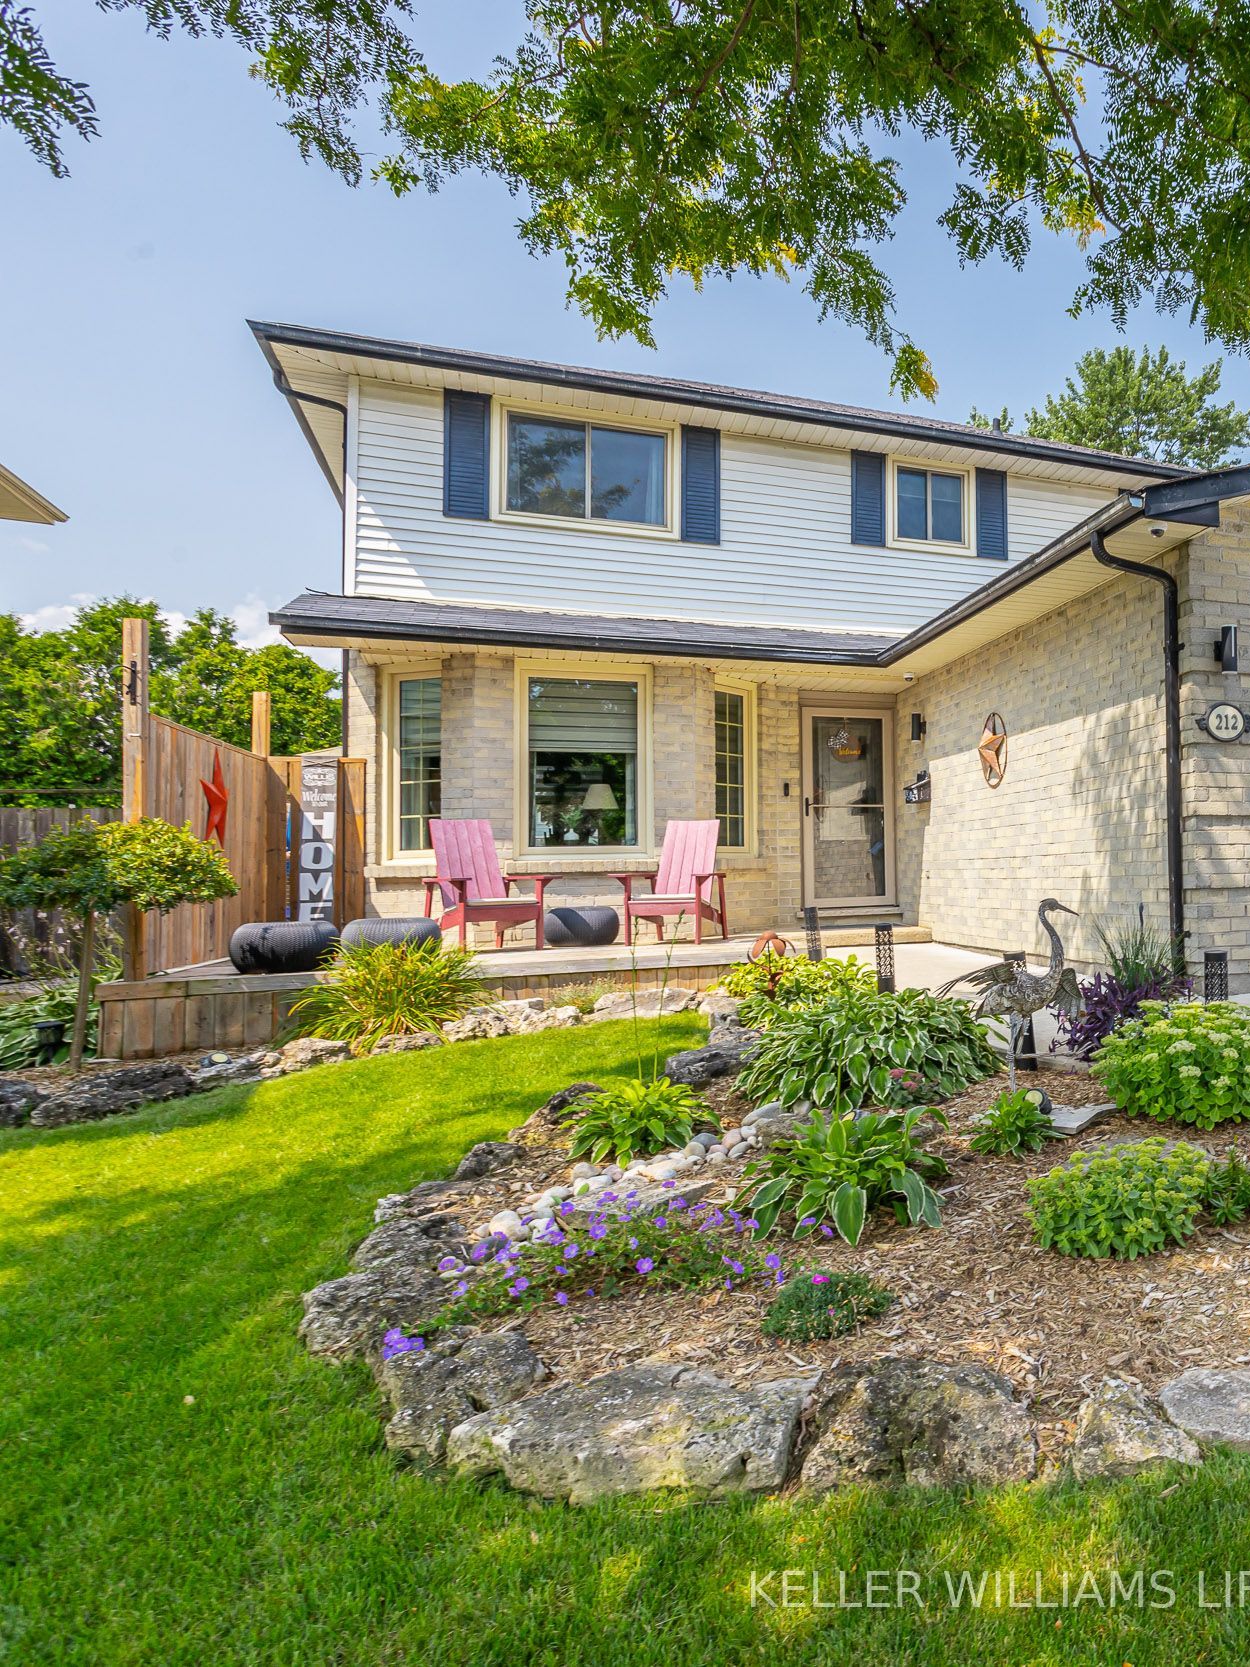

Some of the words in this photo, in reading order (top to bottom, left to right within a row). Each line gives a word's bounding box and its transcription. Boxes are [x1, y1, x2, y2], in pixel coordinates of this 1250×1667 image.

[1215, 713, 1239, 731] 212
[302, 788, 337, 802] Welcome
[299, 811, 336, 923] HOME
